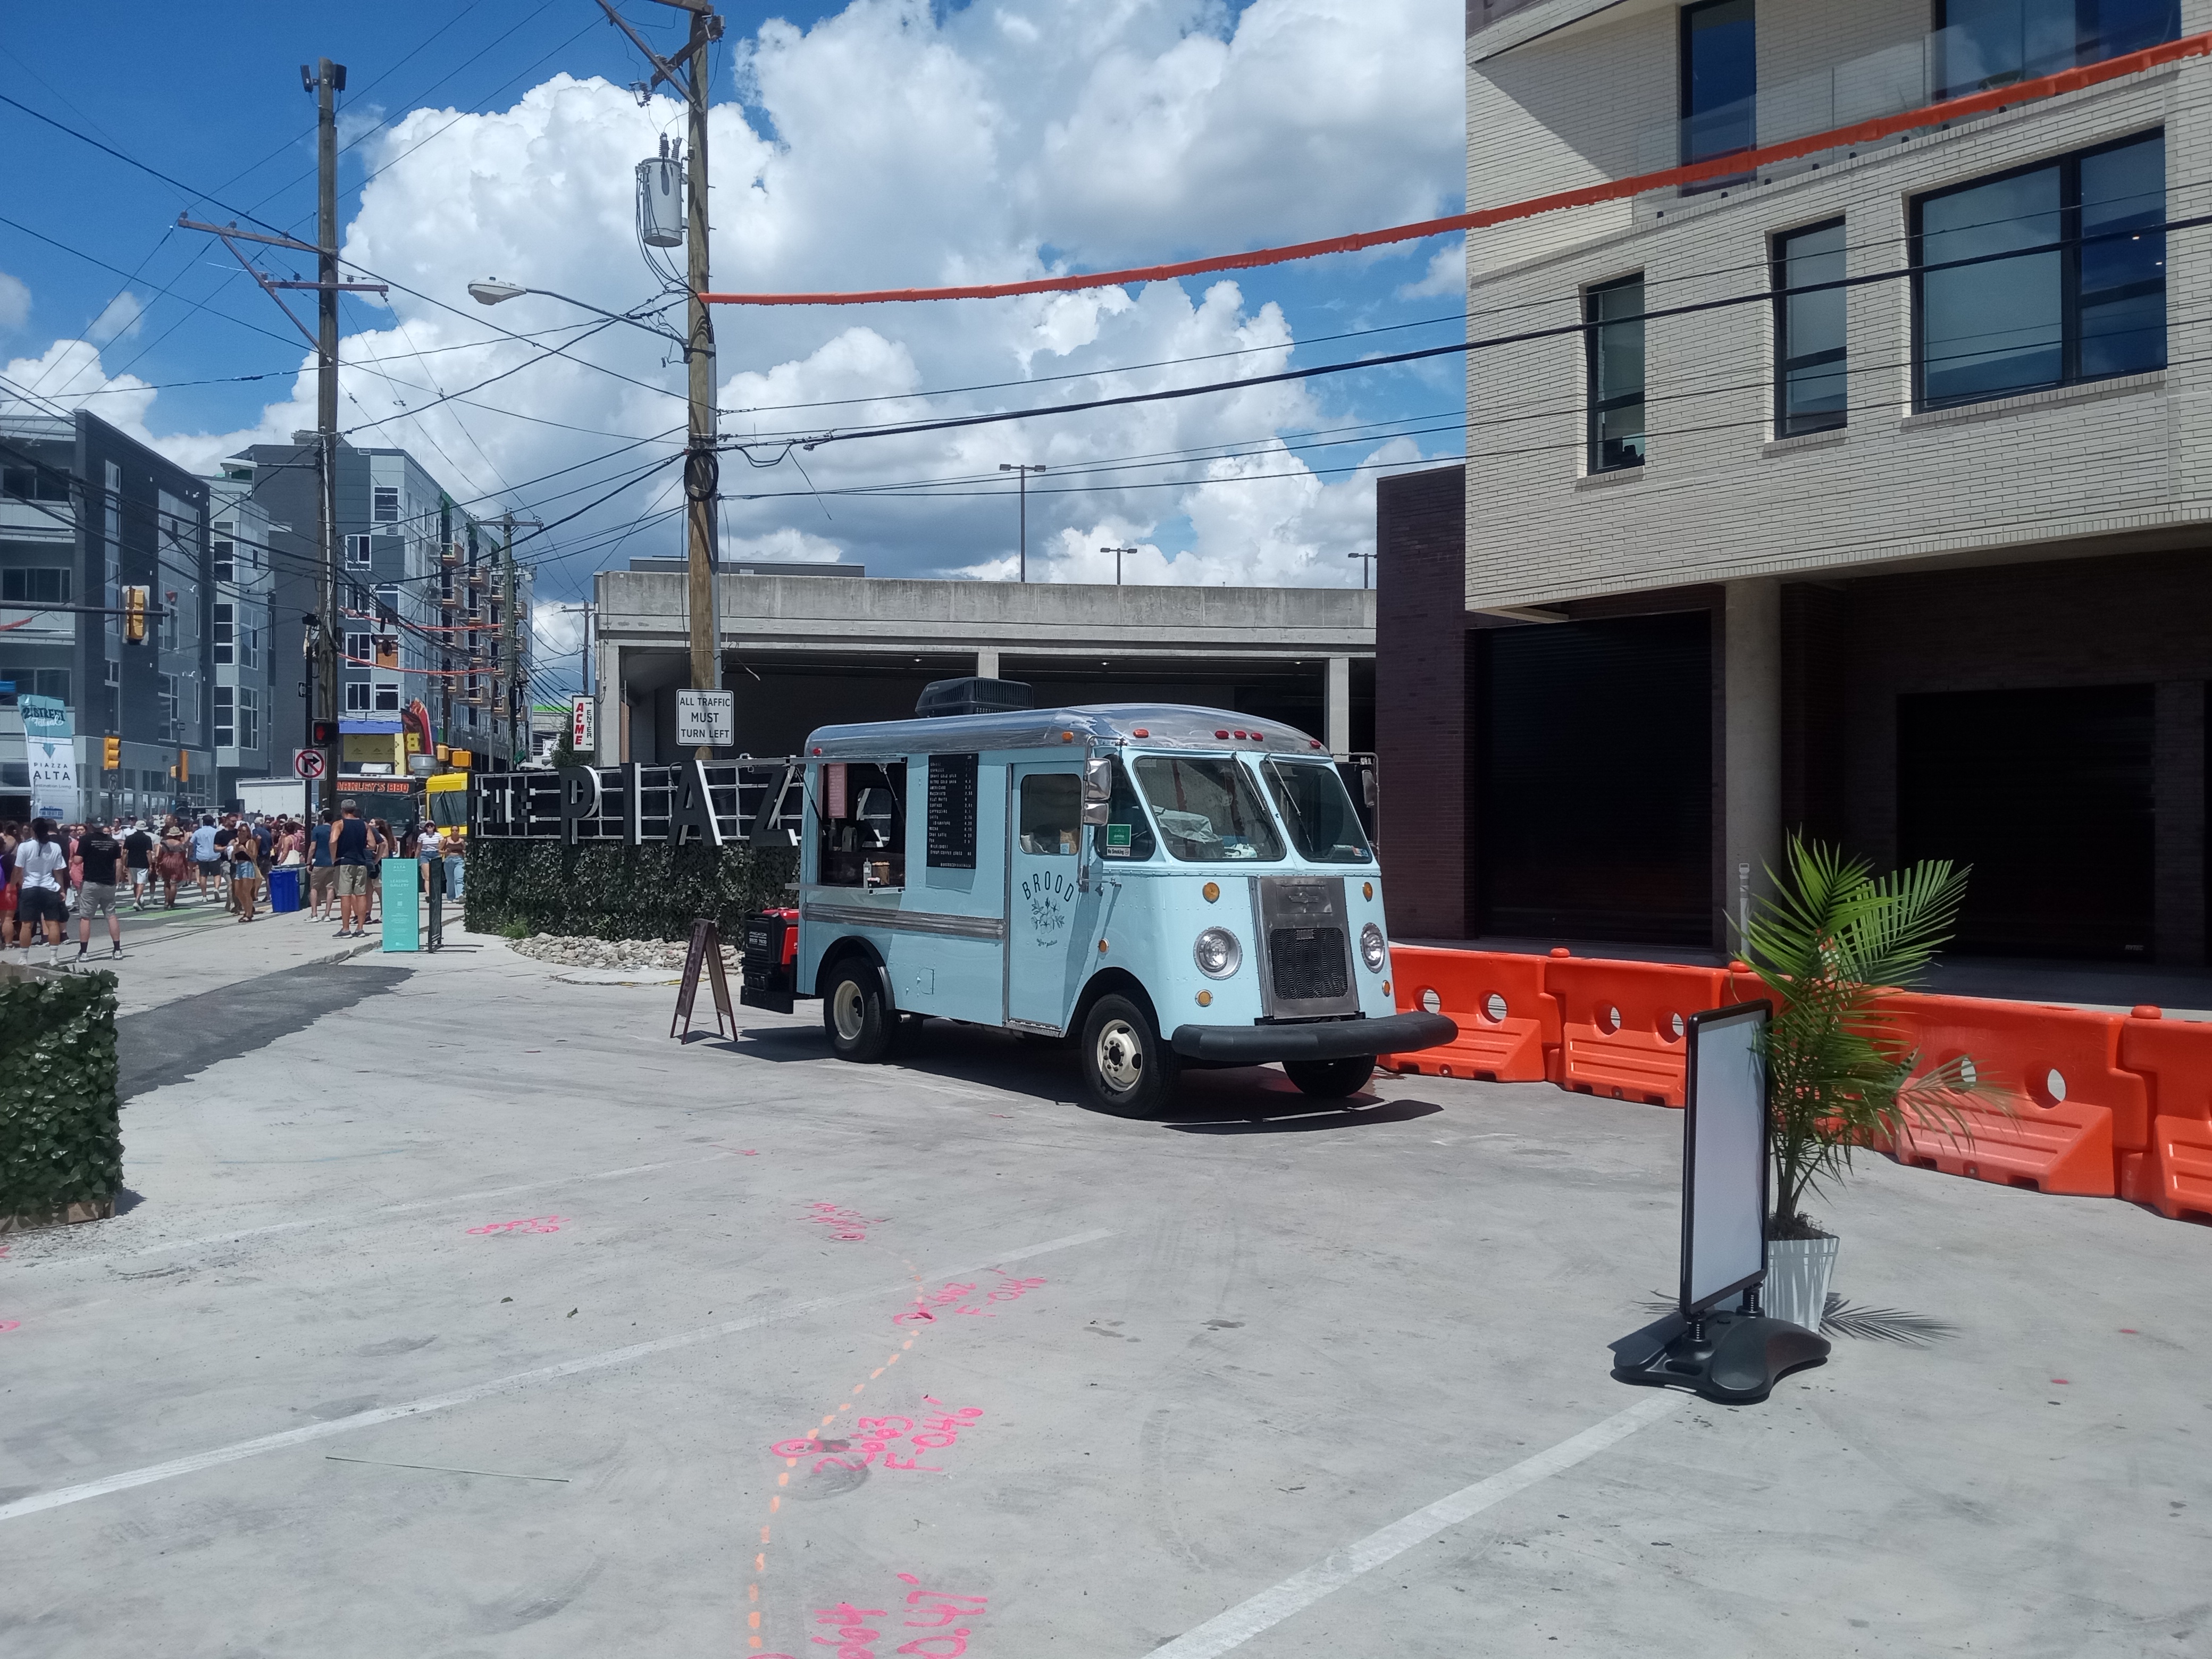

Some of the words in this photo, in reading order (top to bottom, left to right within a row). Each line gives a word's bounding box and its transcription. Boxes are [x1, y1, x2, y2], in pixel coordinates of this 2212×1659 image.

[680, 697, 694, 706] ALL
[697, 698, 730, 707] TRAFFIC
[33, 707, 65, 722] STREET
[691, 712, 719, 723] MUST
[575, 703, 584, 745] ACME
[681, 729, 705, 738] TURN
[33, 770, 70, 781] ALTA
[337, 782, 385, 792] ARKLEY'S
[387, 783, 409, 793] BBQ
[557, 759, 798, 847] PIAZ
[1022, 871, 1074, 902] BROOD
